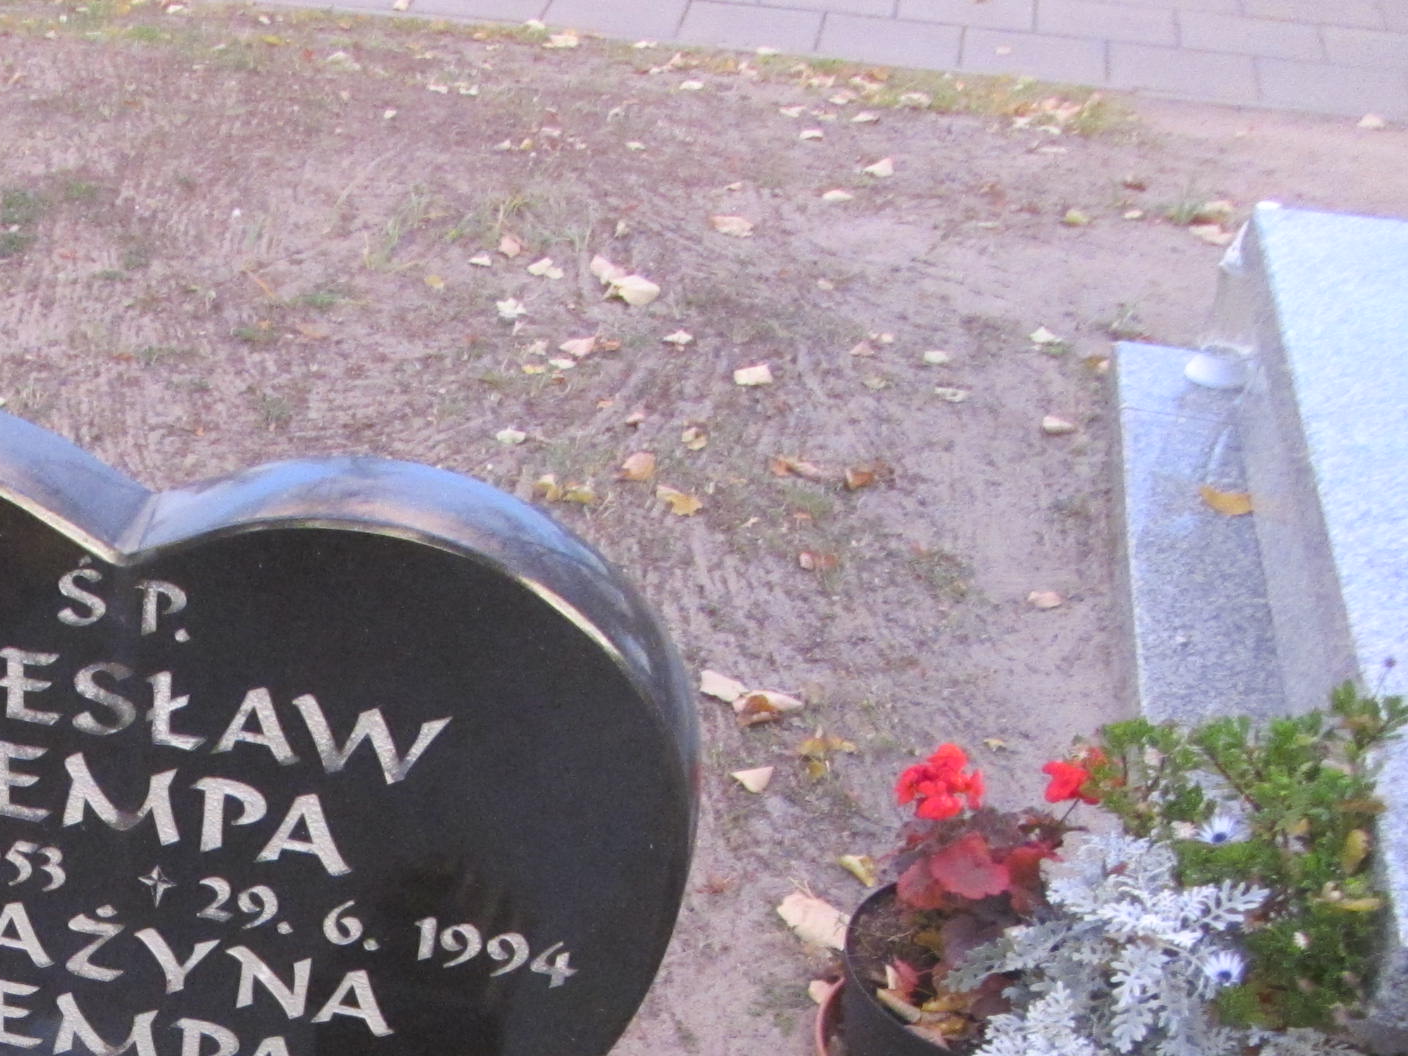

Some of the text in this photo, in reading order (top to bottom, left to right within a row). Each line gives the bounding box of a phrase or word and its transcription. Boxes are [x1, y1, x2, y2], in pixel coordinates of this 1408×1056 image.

[56, 557, 191, 643] Ś P.
[196, 875, 295, 936] 29.
[322, 898, 380, 952] 6.
[414, 915, 579, 990] 1994
